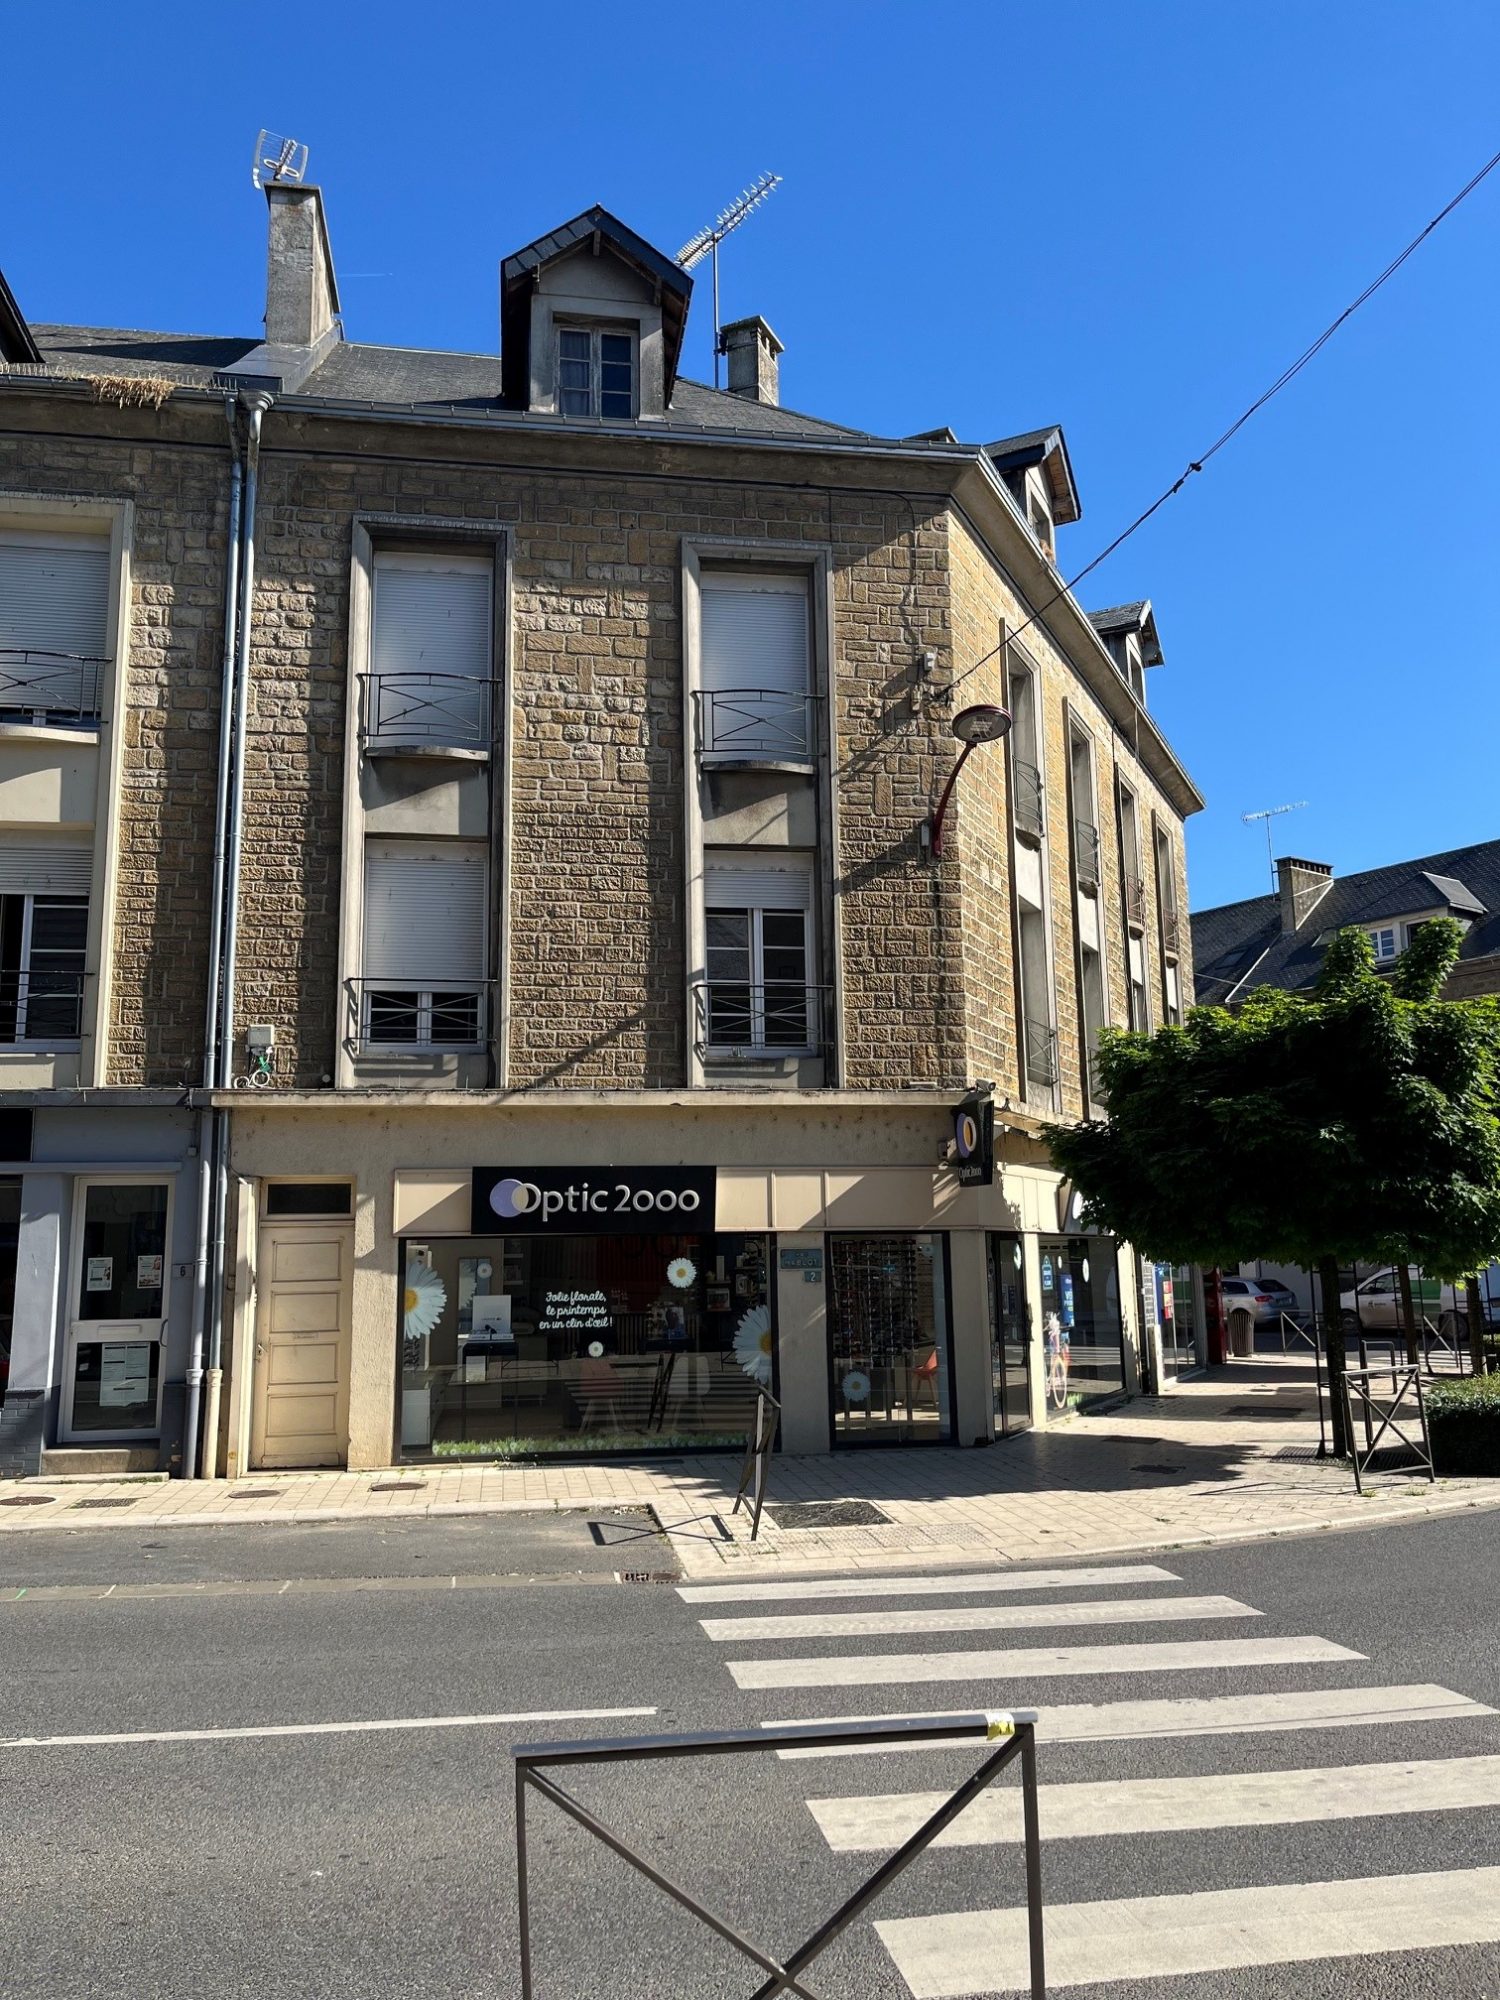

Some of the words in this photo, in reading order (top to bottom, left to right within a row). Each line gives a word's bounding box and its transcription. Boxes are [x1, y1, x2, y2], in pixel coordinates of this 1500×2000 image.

[511, 1182, 609, 1222] Optic
[614, 1184, 700, 1212] 2000
[180, 1265, 186, 1277] 6
[810, 1271, 816, 1282] 2
[570, 1290, 606, 1306] florale,
[546, 1305, 556, 1316] le
[556, 1304, 607, 1319] printemps
[539, 1320, 551, 1330] en
[551, 1320, 565, 1329] un
[565, 1317, 585, 1328] clin
